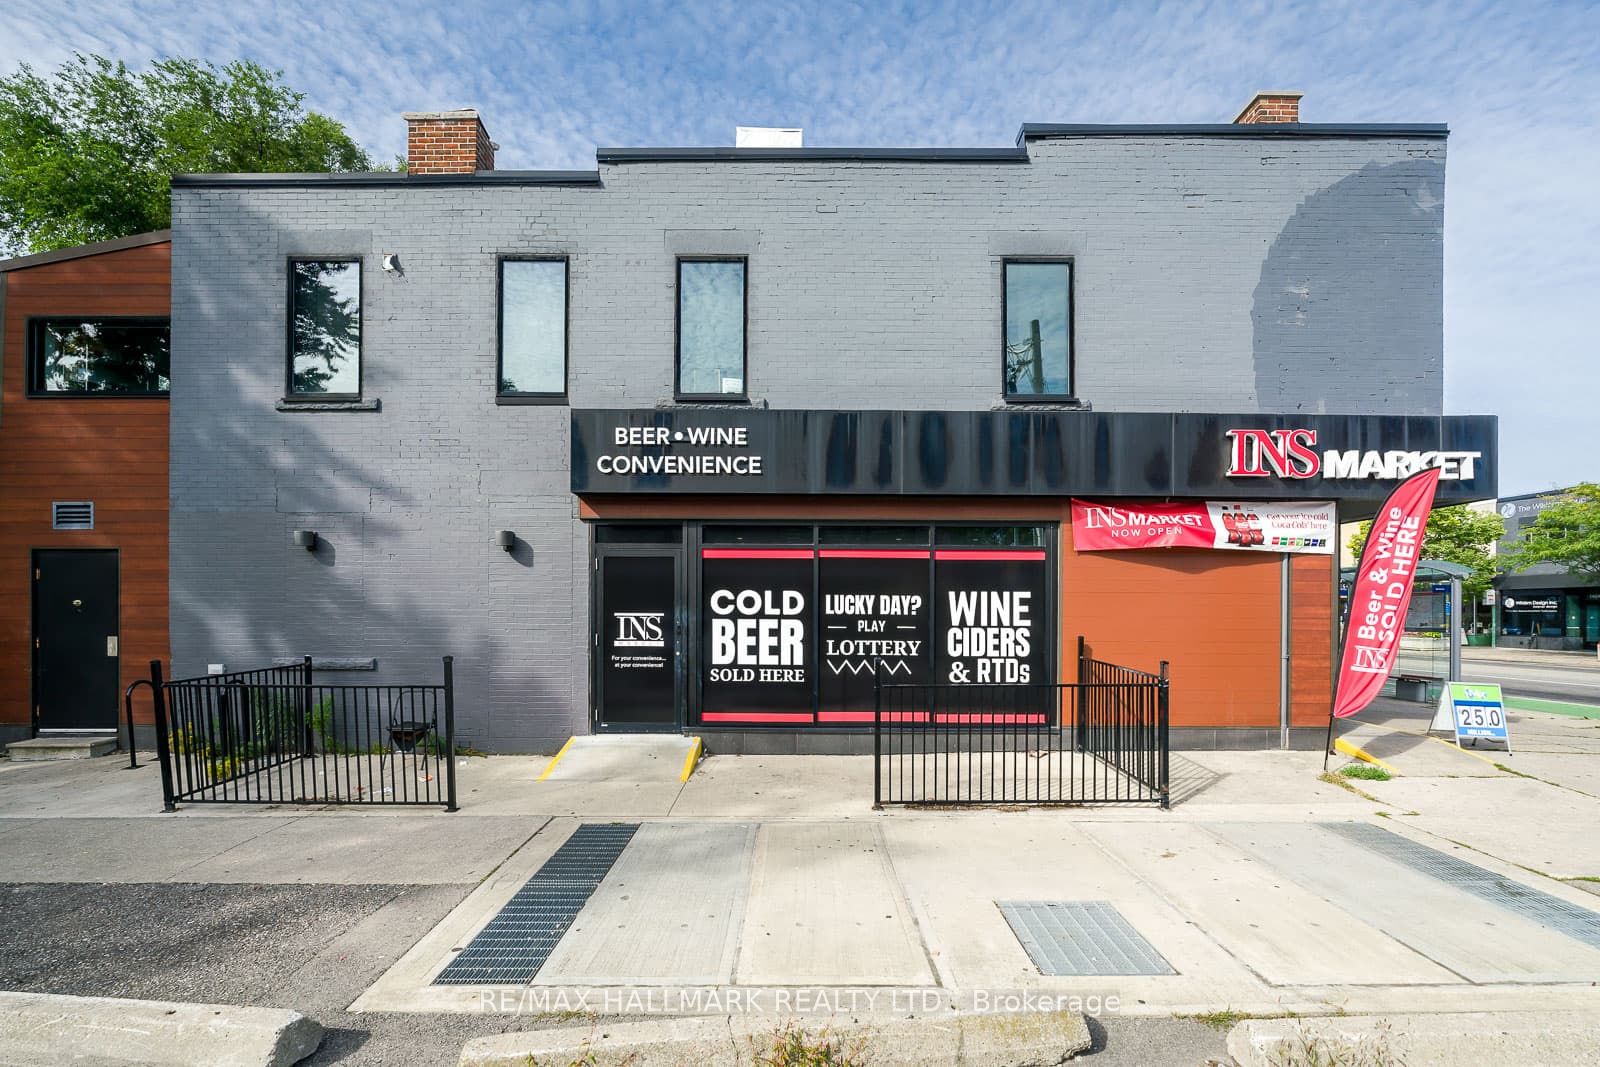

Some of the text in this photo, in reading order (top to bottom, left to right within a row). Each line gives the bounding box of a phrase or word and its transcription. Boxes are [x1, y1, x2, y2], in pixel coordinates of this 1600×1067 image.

[615, 427, 747, 445] BEER WINE
[597, 455, 762, 474] CONVENIENCE
[1226, 429, 1482, 480] INS MARKET
[1084, 507, 1203, 528] INS MARKET
[1111, 527, 1182, 538] NOW OPEN
[1392, 515, 1420, 575] HERE
[1358, 506, 1402, 640] Beer & Wine
[710, 589, 804, 615] COLD
[825, 594, 922, 615] LUCKY DAY?
[948, 591, 1032, 626] WINE
[615, 616, 664, 640] INS
[857, 620, 886, 632] PLAY
[712, 618, 804, 665] BEER
[826, 640, 922, 656] LOTTERY
[947, 627, 1031, 657] CIDERS
[710, 668, 805, 682] SOLD HERE
[949, 658, 1030, 683] & RTDs
[1461, 709, 1500, 727] 25.0
